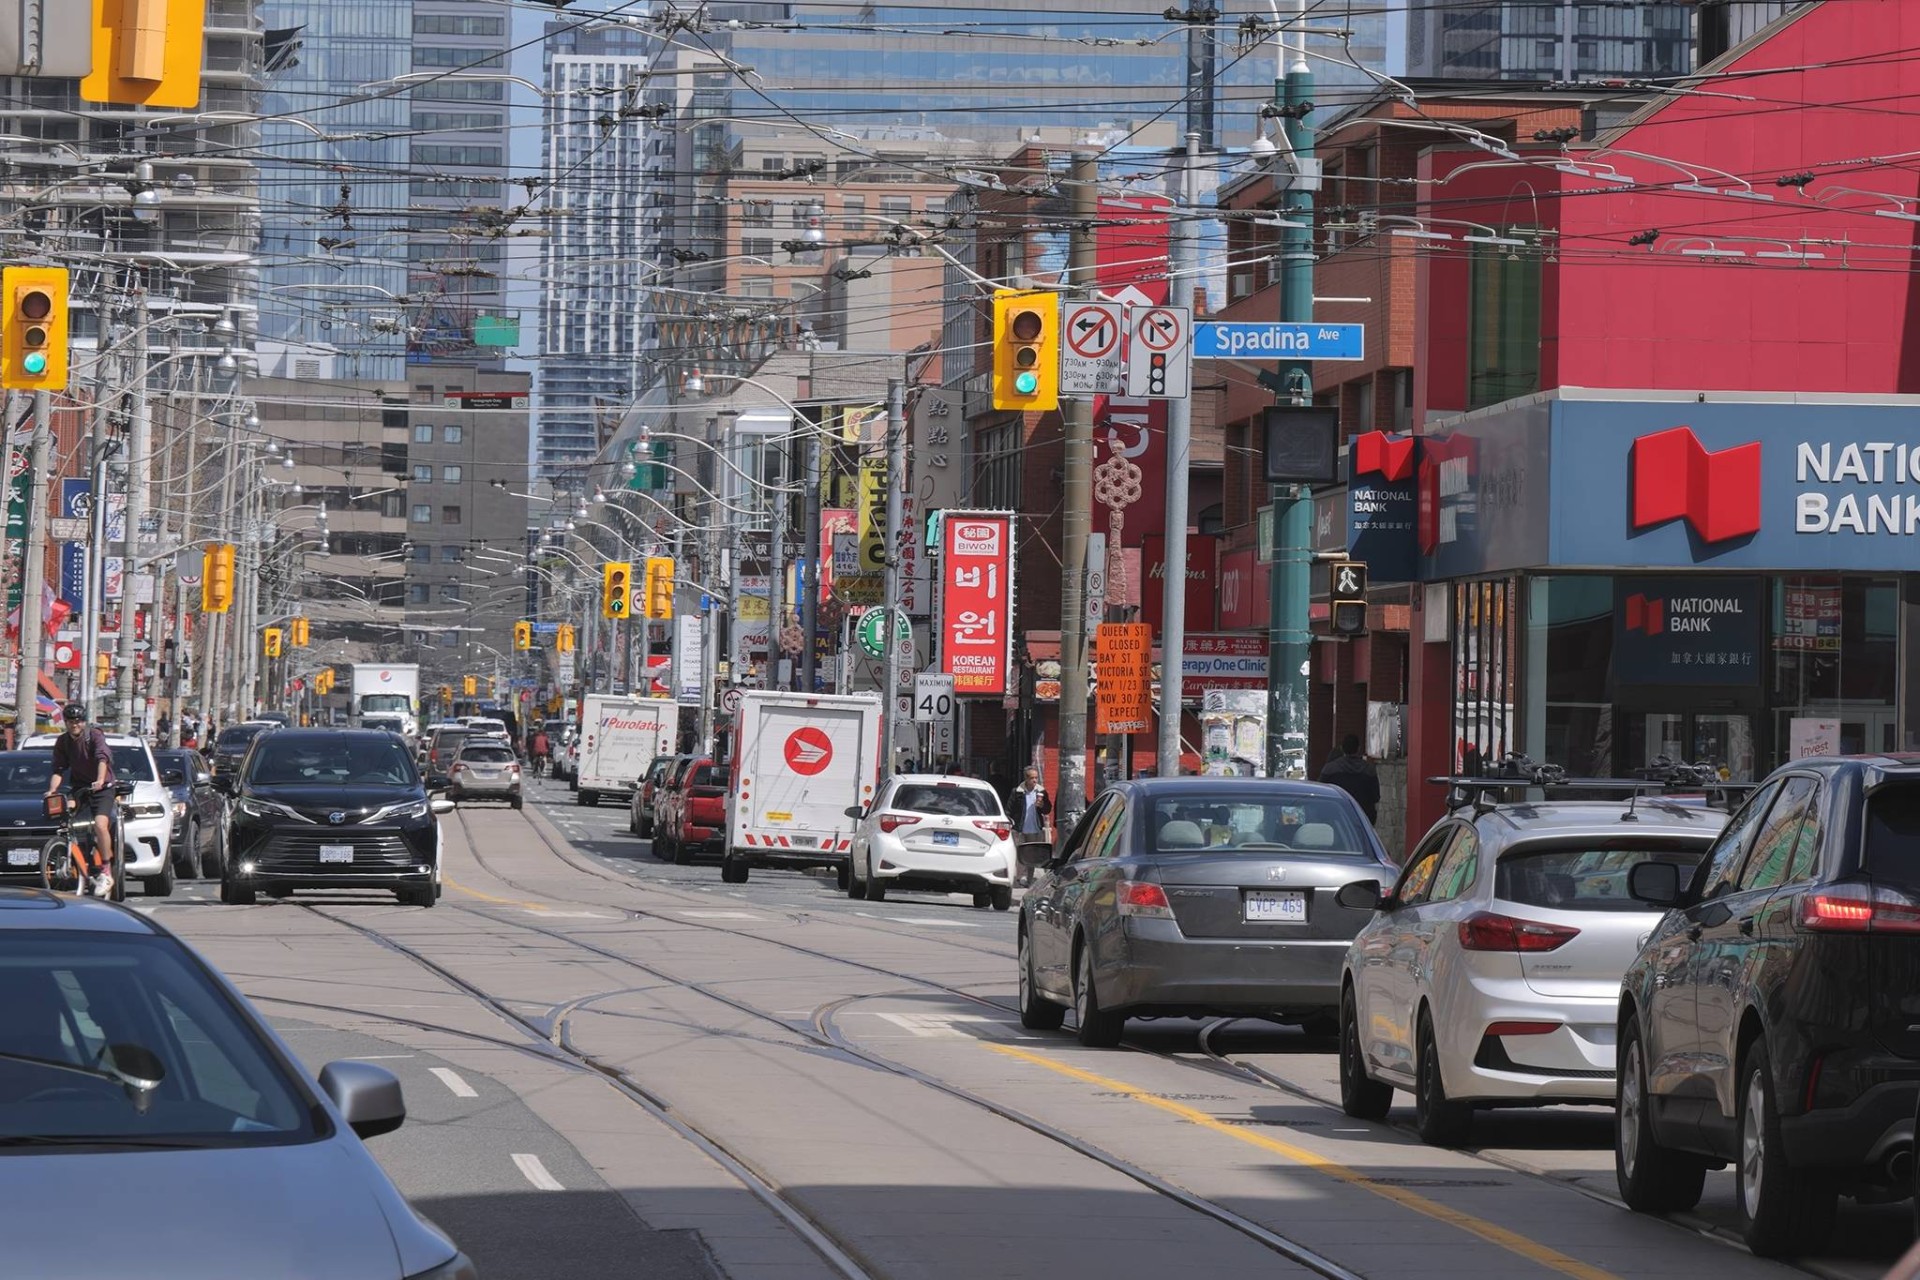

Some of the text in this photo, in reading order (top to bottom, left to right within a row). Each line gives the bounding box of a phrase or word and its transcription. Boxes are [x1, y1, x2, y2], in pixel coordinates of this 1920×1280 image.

[1216, 326, 1340, 355] Spadina Ave
[927, 400, 949, 467] 點點心
[1354, 490, 1412, 501] NATIONAL
[1354, 502, 1387, 513] BANK
[952, 562, 996, 645] 비원
[1671, 598, 1743, 613] NATIONAL
[861, 609, 907, 629] MUNIAL
[1671, 617, 1711, 632] BANK
[1102, 626, 1147, 637] QUEEN ST.
[1109, 640, 1140, 650] CLOSED
[953, 655, 995, 665] KOREAN
[1100, 653, 1150, 664] BAY ST. TO
[1671, 651, 1751, 666] 加拿大國家銀行
[953, 666, 995, 674] RESTAURANT
[1099, 666, 1134, 677] VICTORIA
[1182, 659, 1266, 673] erapy One Clinic
[919, 679, 952, 687] MAXIMUM
[1099, 680, 1150, 691] MAY 1/23 TO
[919, 694, 951, 715] 40
[1122, 694, 1148, 704] 30/27
[1110, 706, 1139, 717] EXPECT
[608, 717, 666, 731] Purolator
[1800, 740, 1829, 758] Invest
[1249, 898, 1302, 913] CVCP 469
